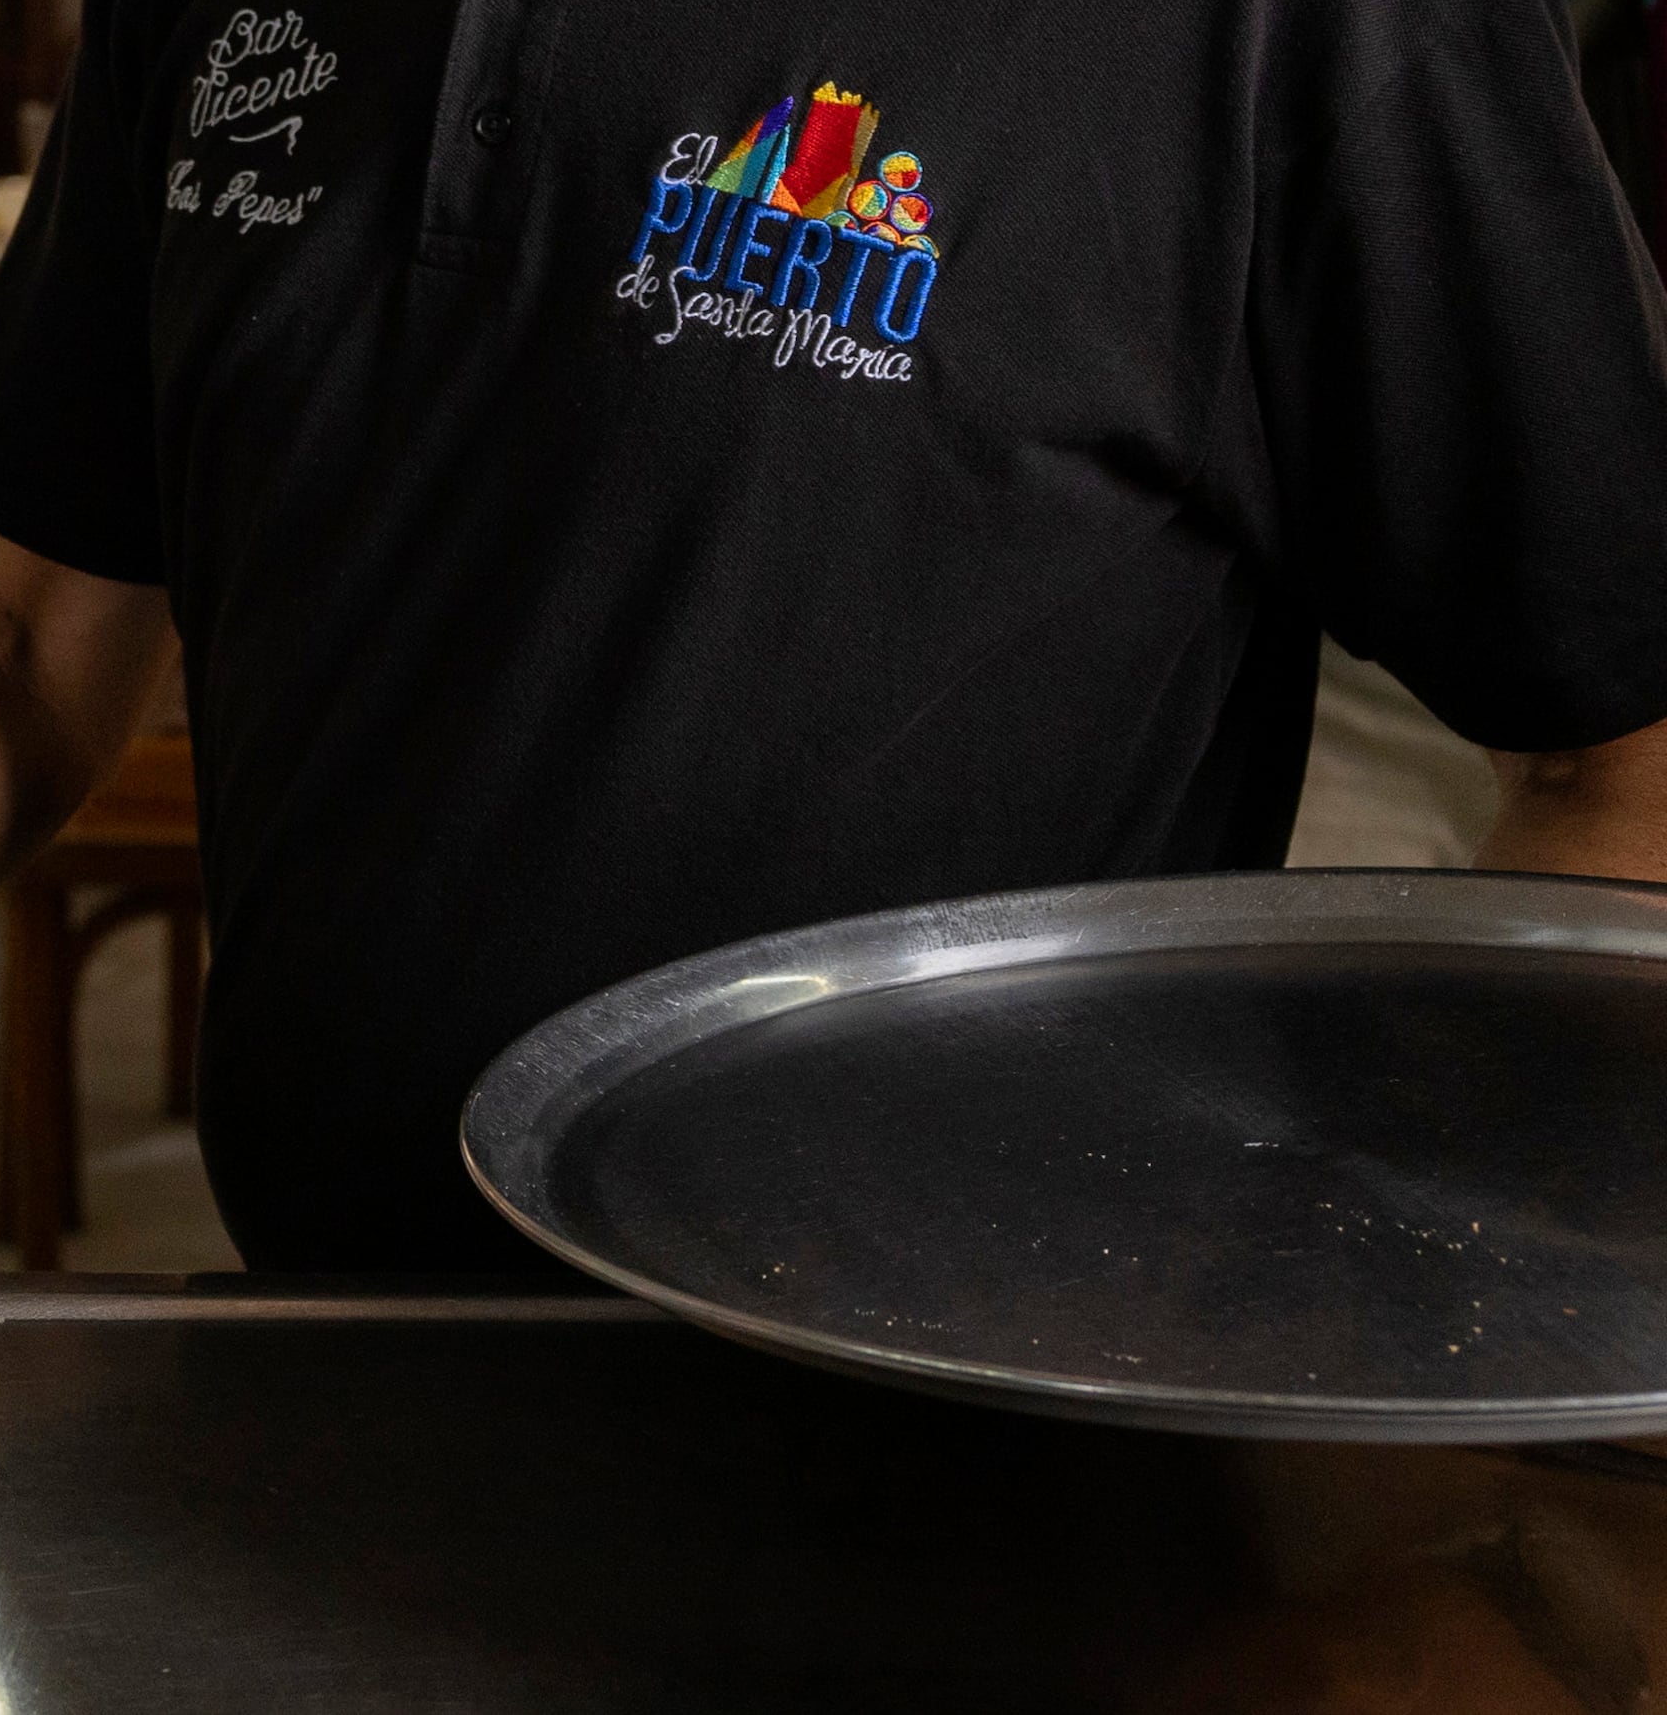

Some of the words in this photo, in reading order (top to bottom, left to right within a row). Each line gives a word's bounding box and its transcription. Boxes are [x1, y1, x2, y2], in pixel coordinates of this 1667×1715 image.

[208, 8, 309, 68] Bar
[190, 42, 339, 138] Vicente
[660, 132, 719, 186] El
[616, 254, 660, 309] de
[655, 266, 775, 345] Santa
[629, 176, 938, 343] PUERTO
